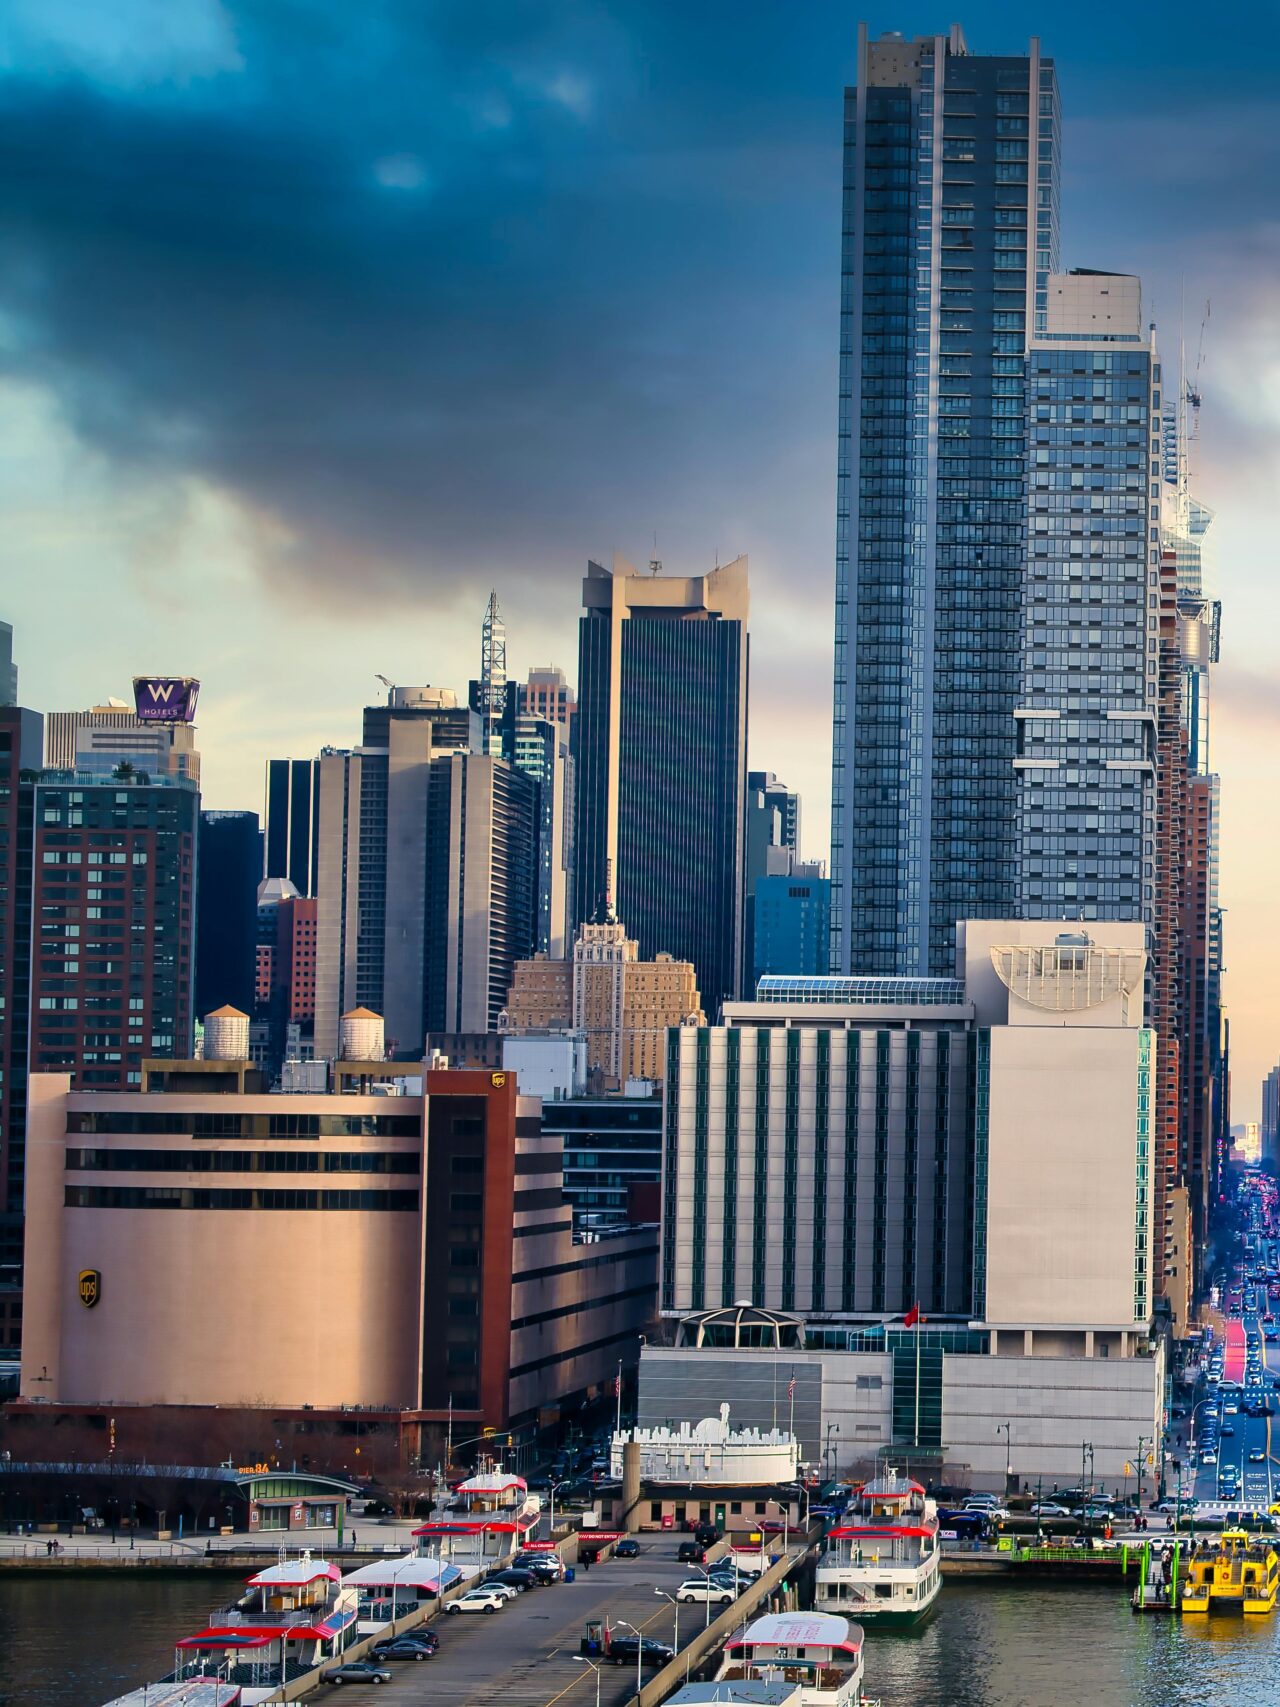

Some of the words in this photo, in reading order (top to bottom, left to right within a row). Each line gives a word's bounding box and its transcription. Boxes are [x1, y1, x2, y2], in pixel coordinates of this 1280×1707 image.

[147, 684, 174, 703] W
[144, 708, 178, 716] HOTELS
[81, 1281, 97, 1301] ups
[238, 1466, 255, 1474] PIER
[255, 1463, 269, 1473] 84
